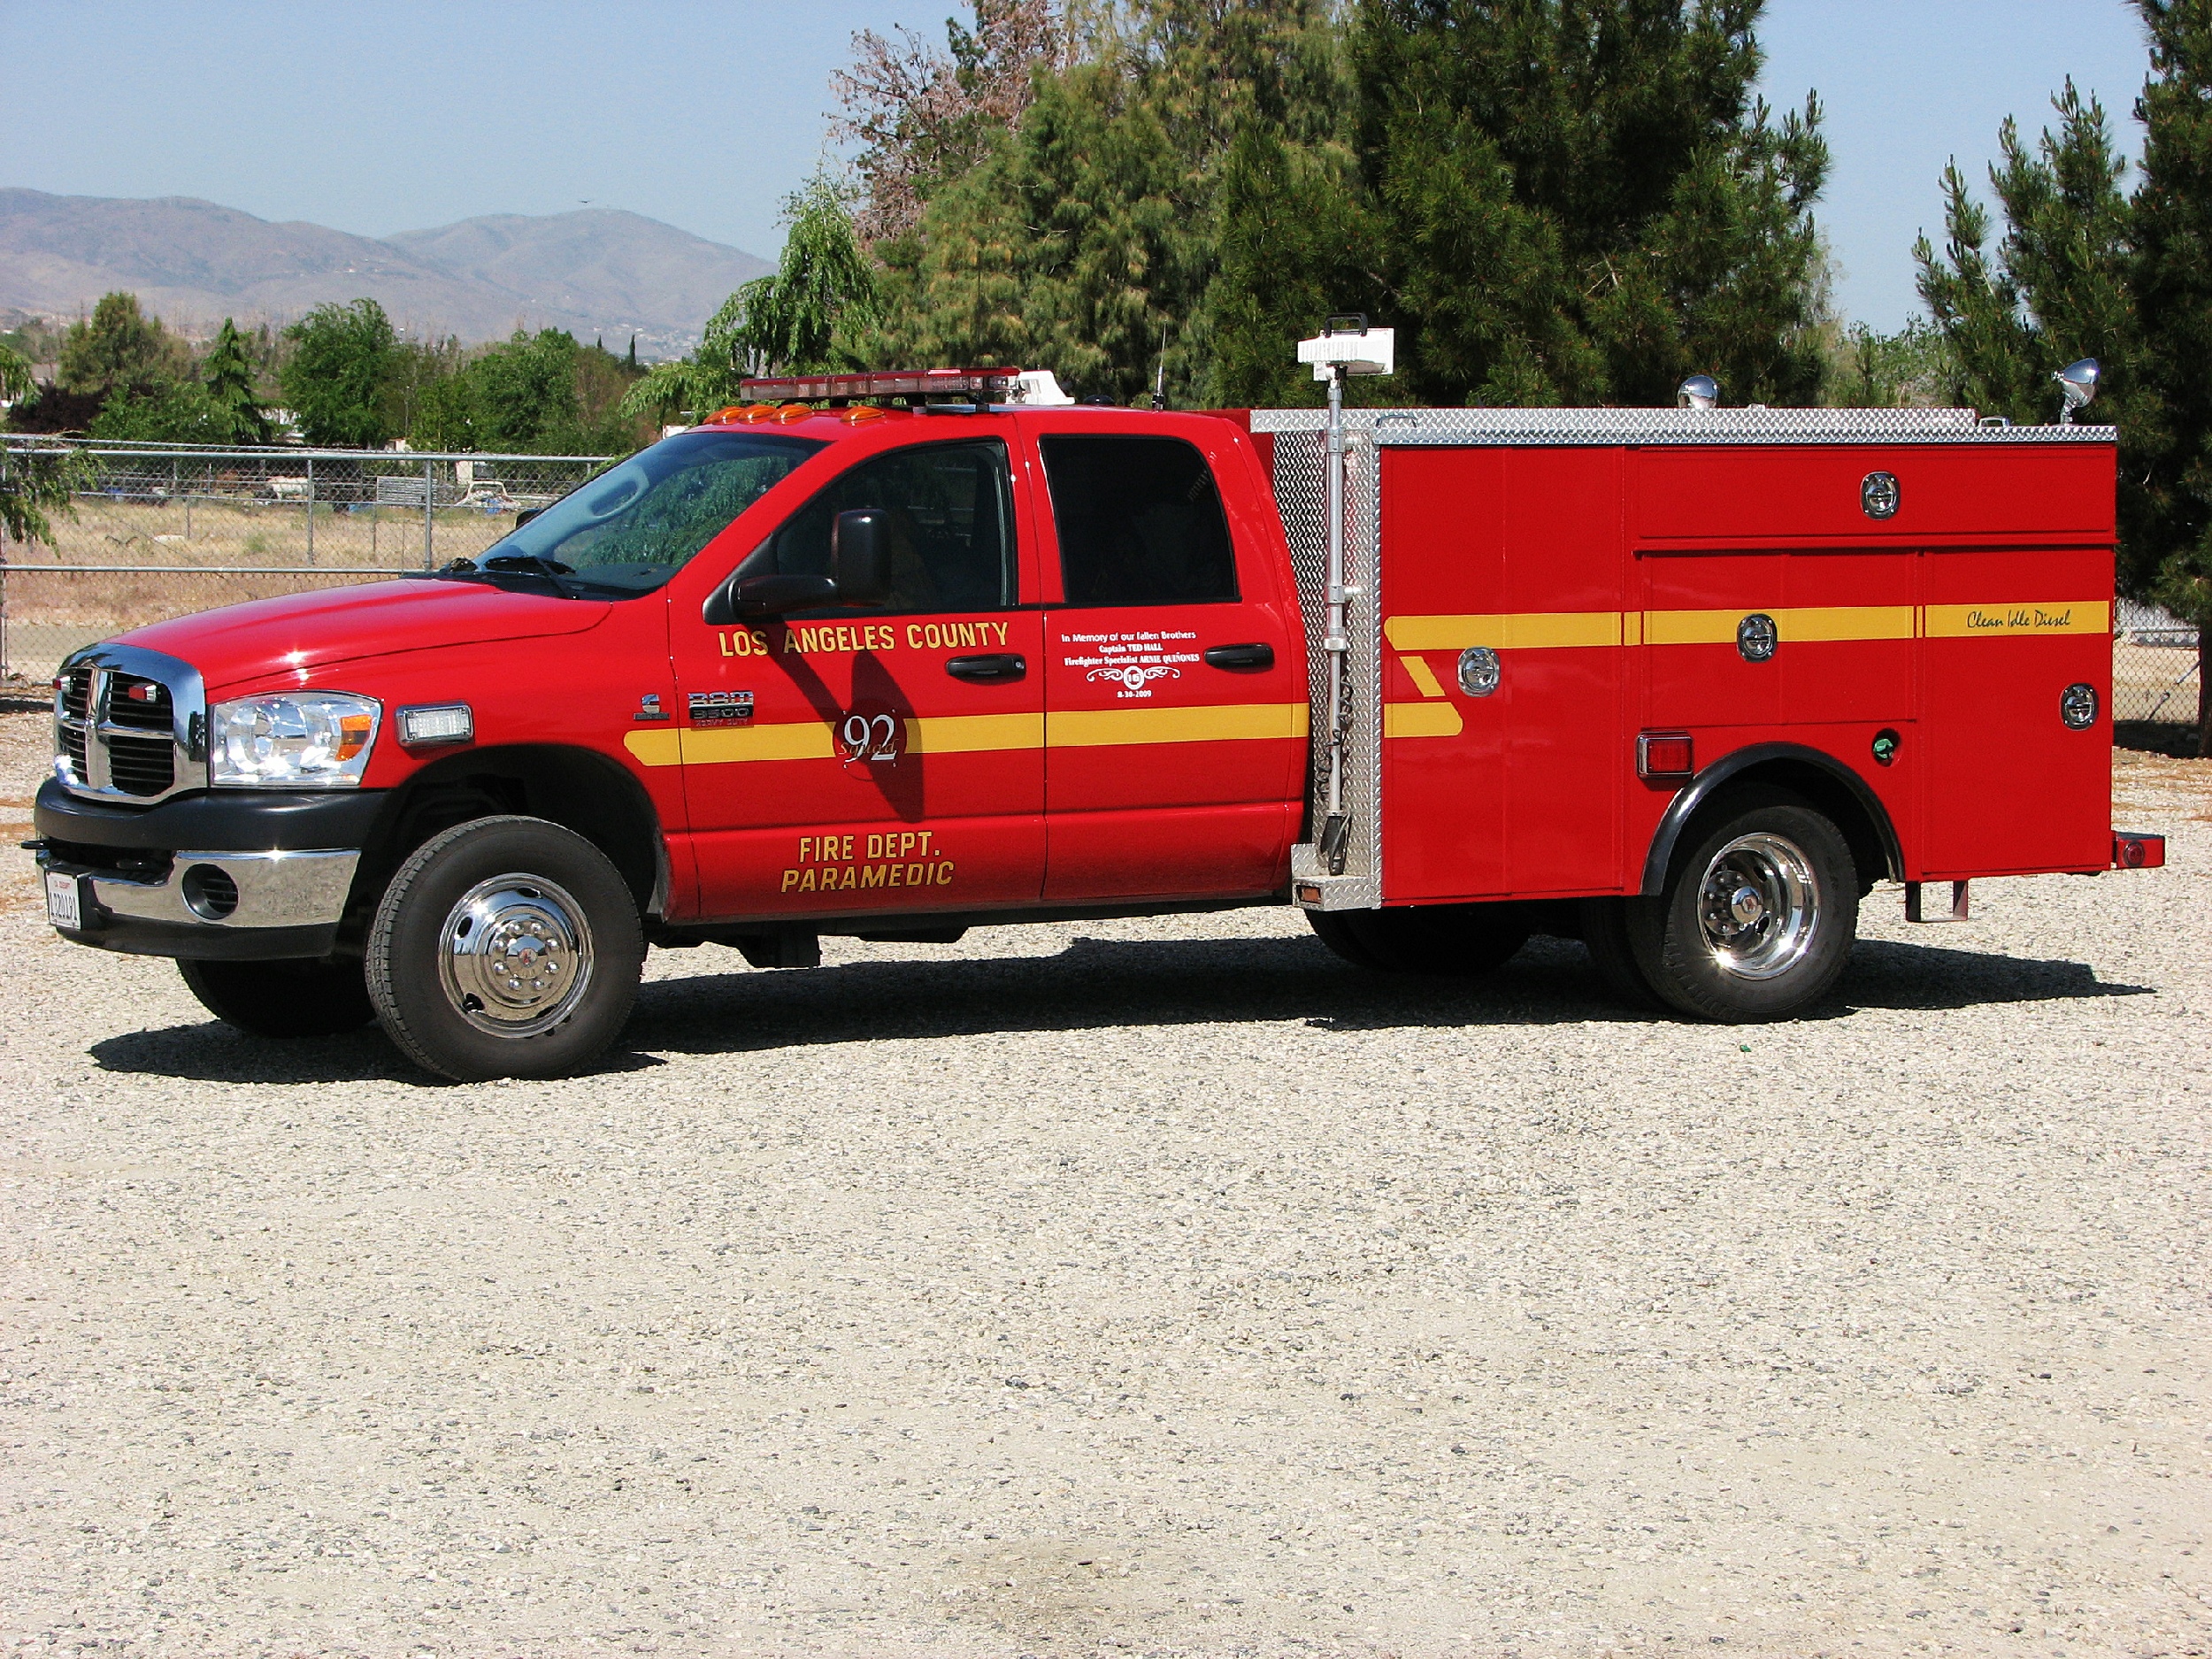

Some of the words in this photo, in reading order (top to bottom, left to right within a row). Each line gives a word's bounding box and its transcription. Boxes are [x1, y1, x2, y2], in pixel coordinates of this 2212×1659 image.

[1967, 611, 2004, 628] Clean
[2008, 609, 2030, 627] Idle
[2034, 609, 2071, 627] Diesel
[718, 630, 769, 657] LOS
[783, 625, 895, 654] ANGELES
[906, 621, 1009, 649] COUNTY
[1061, 634, 1071, 642] In
[1072, 634, 1108, 643] Memory
[1110, 632, 1118, 641] of
[1161, 630, 1196, 640] Brothers
[1098, 644, 1126, 655] Captain
[1144, 642, 1164, 651] HALL
[1064, 657, 1103, 667] Firefighter
[1103, 655, 1139, 666] Specialist
[687, 690, 755, 709] RAM
[693, 707, 749, 720] 3500
[843, 714, 897, 763] 92
[799, 835, 855, 863] FIRE
[867, 831, 941, 859] DEPT.
[780, 860, 955, 893] PARAMEDIC
